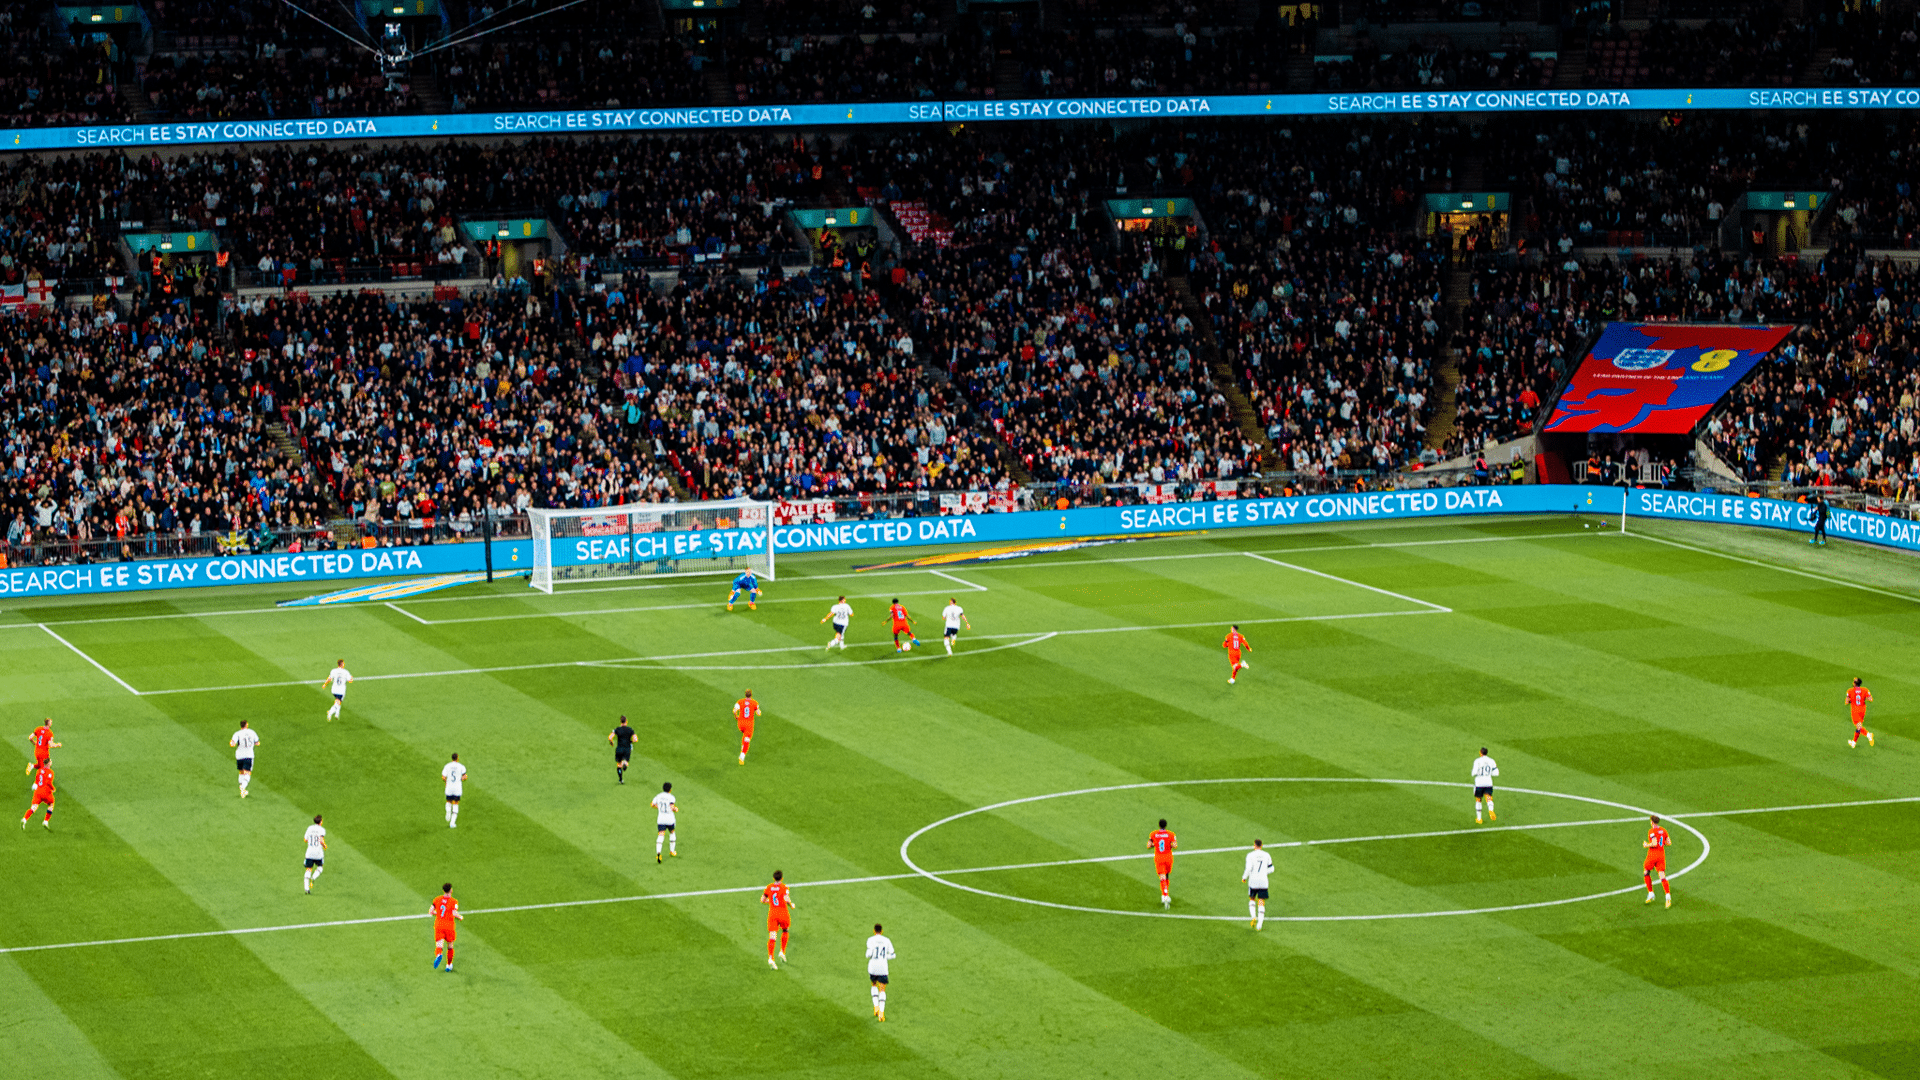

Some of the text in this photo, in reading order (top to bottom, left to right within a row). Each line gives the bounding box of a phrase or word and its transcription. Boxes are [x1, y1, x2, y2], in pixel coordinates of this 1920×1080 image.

[1329, 92, 1630, 110] SEARCH EE STAY CONNECTED DATA
[1750, 91, 1817, 105] SEARCH
[1822, 91, 1843, 105] EE
[1848, 90, 1892, 105] STAY
[909, 98, 1210, 119] SEARCH EE STAY CONNECTED DATA
[494, 108, 792, 130] SEARCH EE STAY CONNECTED DATA
[78, 120, 377, 144] SEARCH EE STAY CONNECTED DATA
[780, 503, 814, 517] VALE
[817, 502, 833, 514] FC
[1120, 489, 1503, 529] SEARCH EE STAY CONNECTED DATA
[1641, 492, 1716, 516] SEARCH
[1721, 498, 1745, 519] EE
[1750, 500, 1793, 522] STAY
[1890, 521, 1920, 545] DAT
[708, 530, 767, 553] STAY
[773, 522, 912, 548] CONNECTED
[919, 518, 977, 540] DATA
[0, 550, 423, 594] SEARCH EE STAY CONNECTED DATA
[450, 770, 457, 783] 5
[1480, 764, 1491, 776] 19
[309, 834, 319, 847] 18
[1256, 860, 1263, 873] 7
[440, 904, 446, 917] 7
[875, 946, 886, 959] 14
